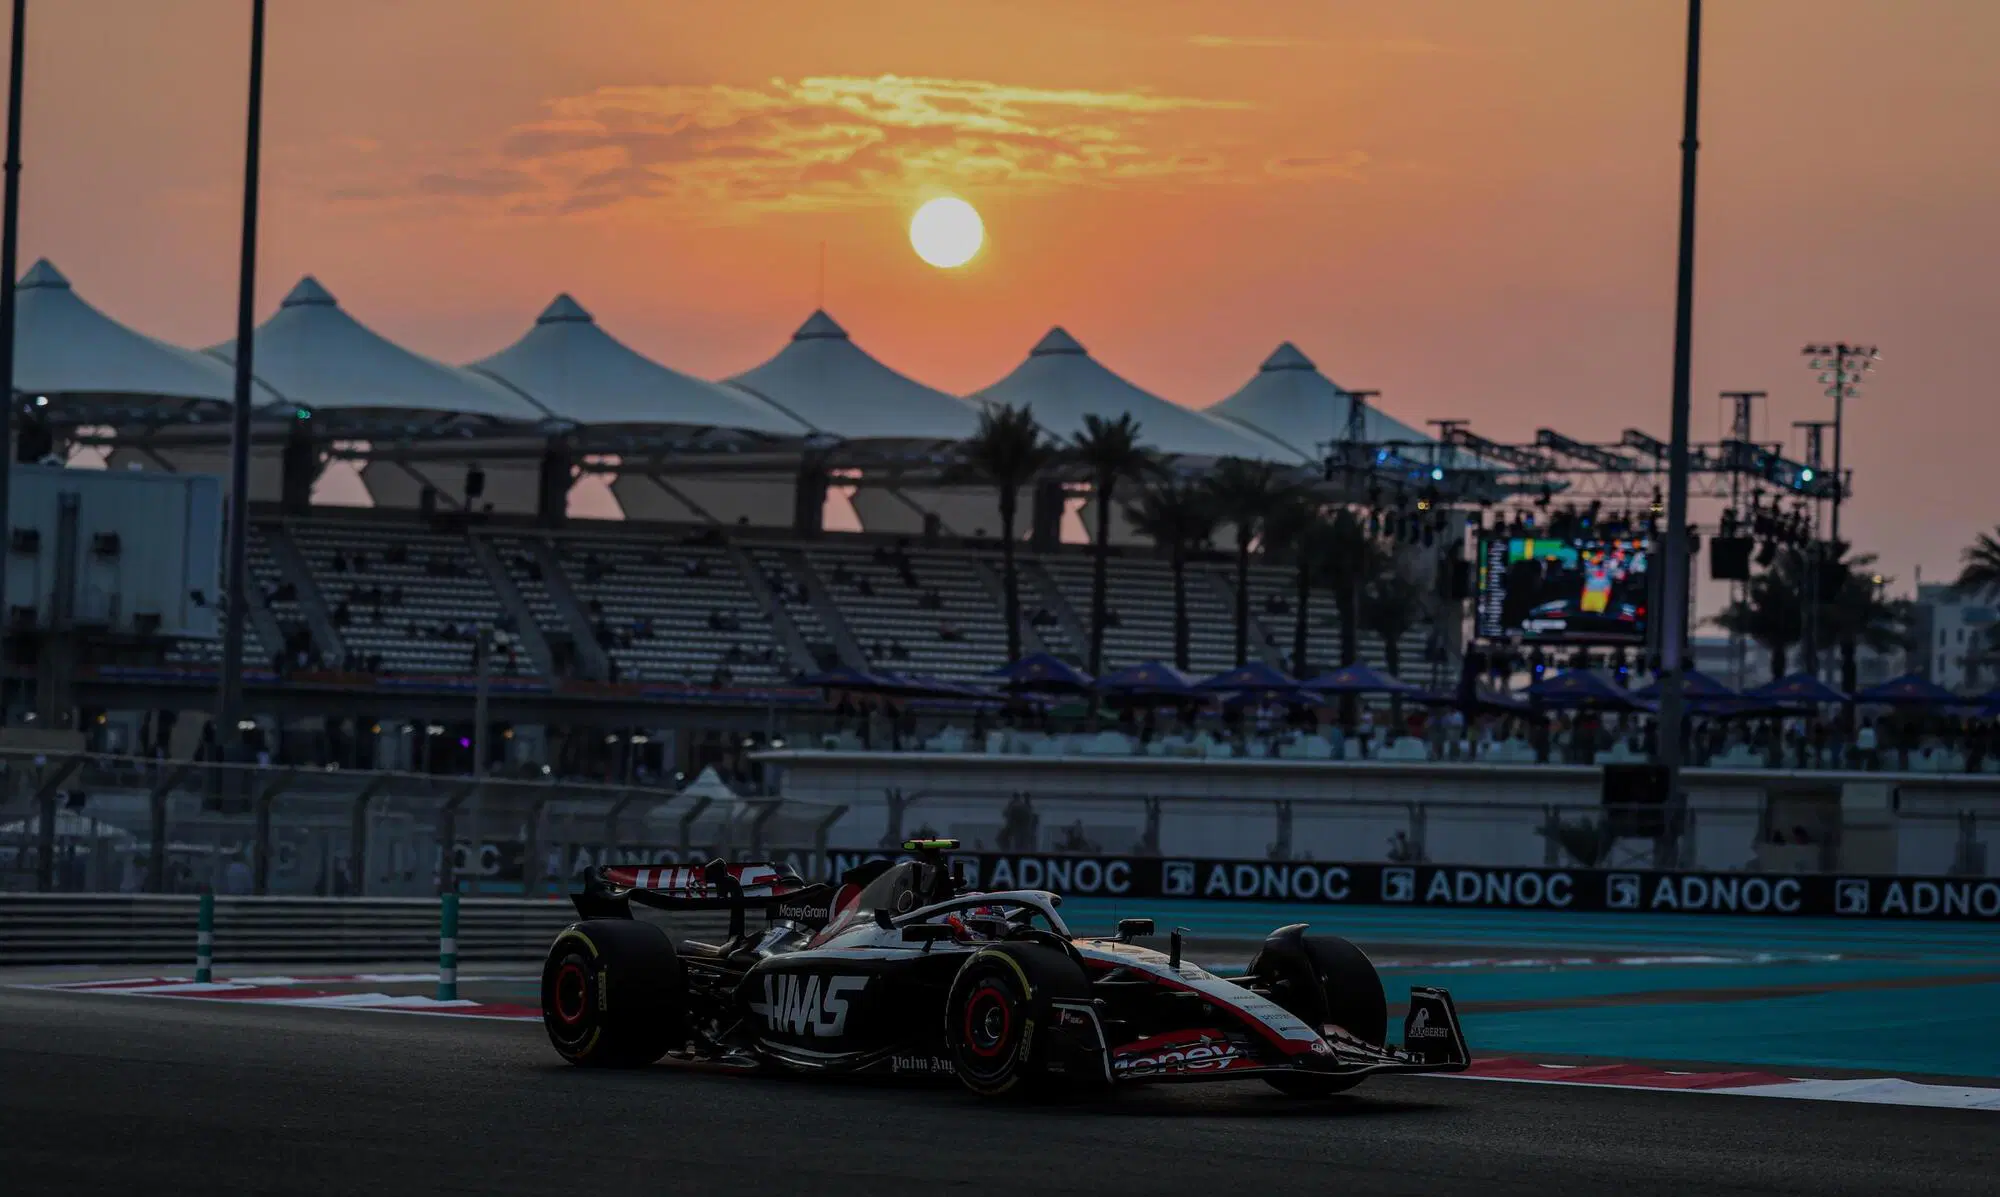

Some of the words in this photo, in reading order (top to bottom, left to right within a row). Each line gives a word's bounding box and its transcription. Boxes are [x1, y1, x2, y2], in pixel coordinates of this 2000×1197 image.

[988, 858, 1132, 894] ADNOC
[1204, 863, 1352, 900] ADNOC
[1425, 869, 1574, 907] ADNOC
[1651, 875, 1802, 913] ADNOC
[779, 903, 828, 920] MoneyGram
[1880, 880, 2000, 917] ADNO
[748, 974, 870, 1036] HAAS
[891, 1055, 928, 1073] Palm
